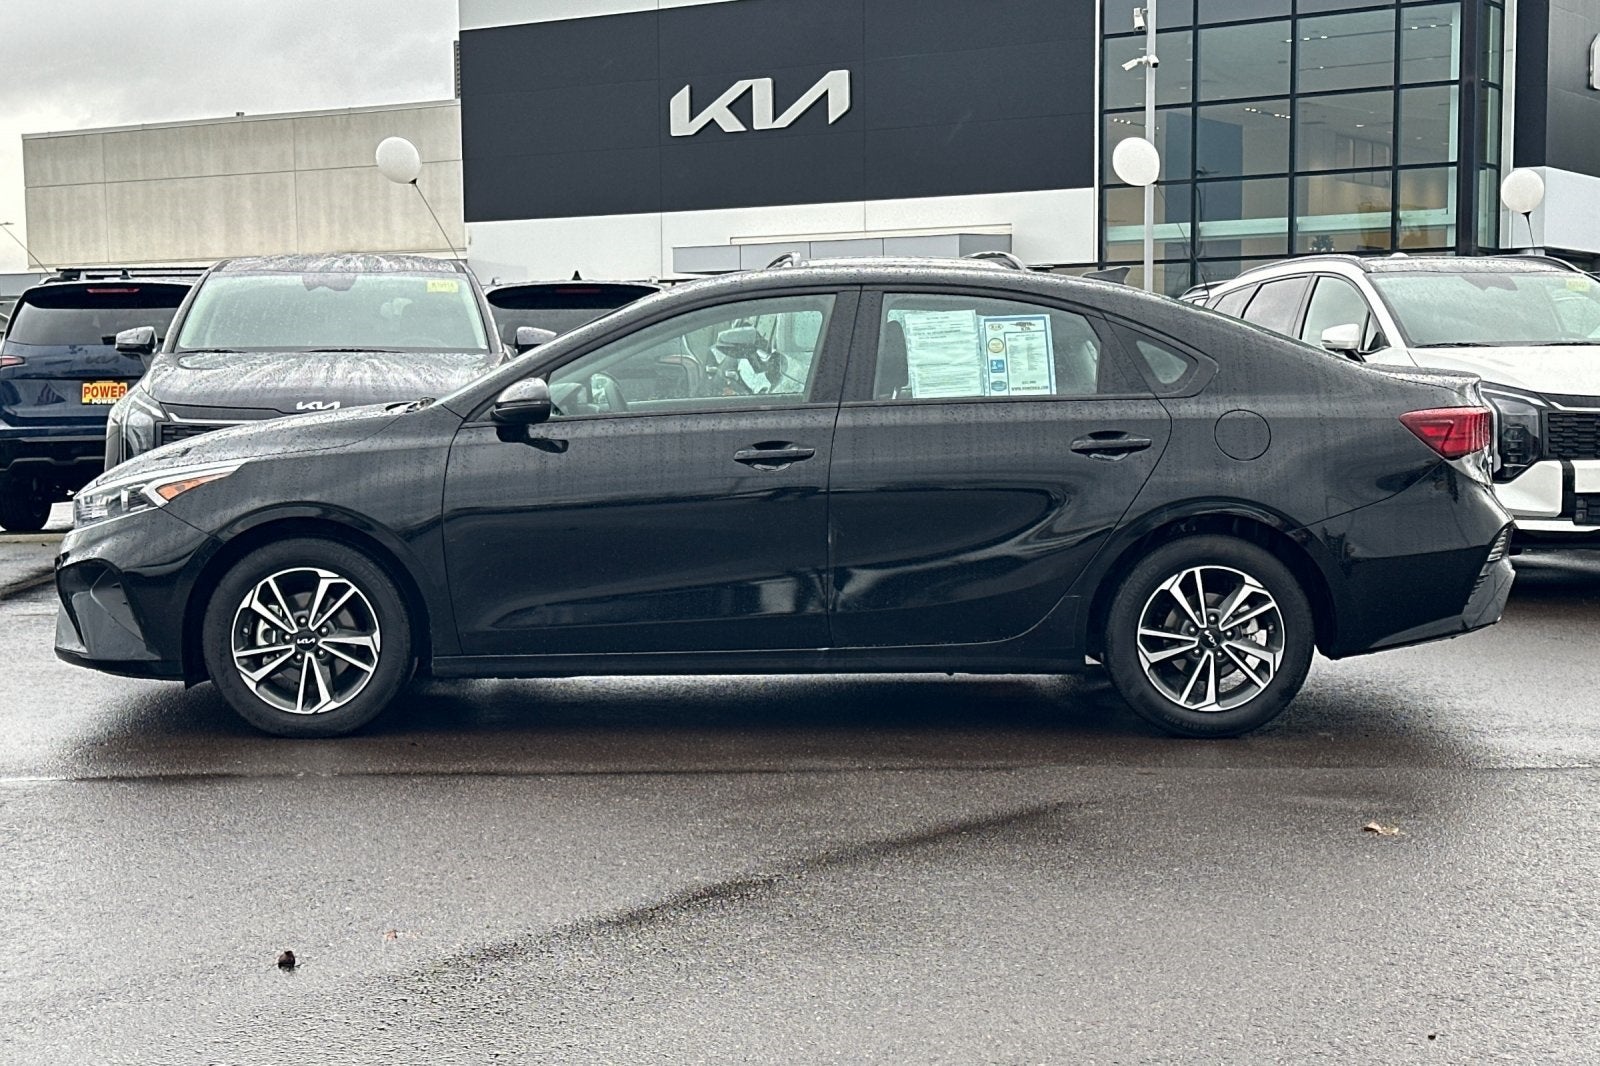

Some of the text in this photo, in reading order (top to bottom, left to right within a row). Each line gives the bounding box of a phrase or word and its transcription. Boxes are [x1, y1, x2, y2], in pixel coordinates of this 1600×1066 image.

[670, 69, 850, 137] KIA
[83, 385, 126, 398] POWER
[296, 400, 341, 410] KIA
[296, 637, 316, 645] KIA
